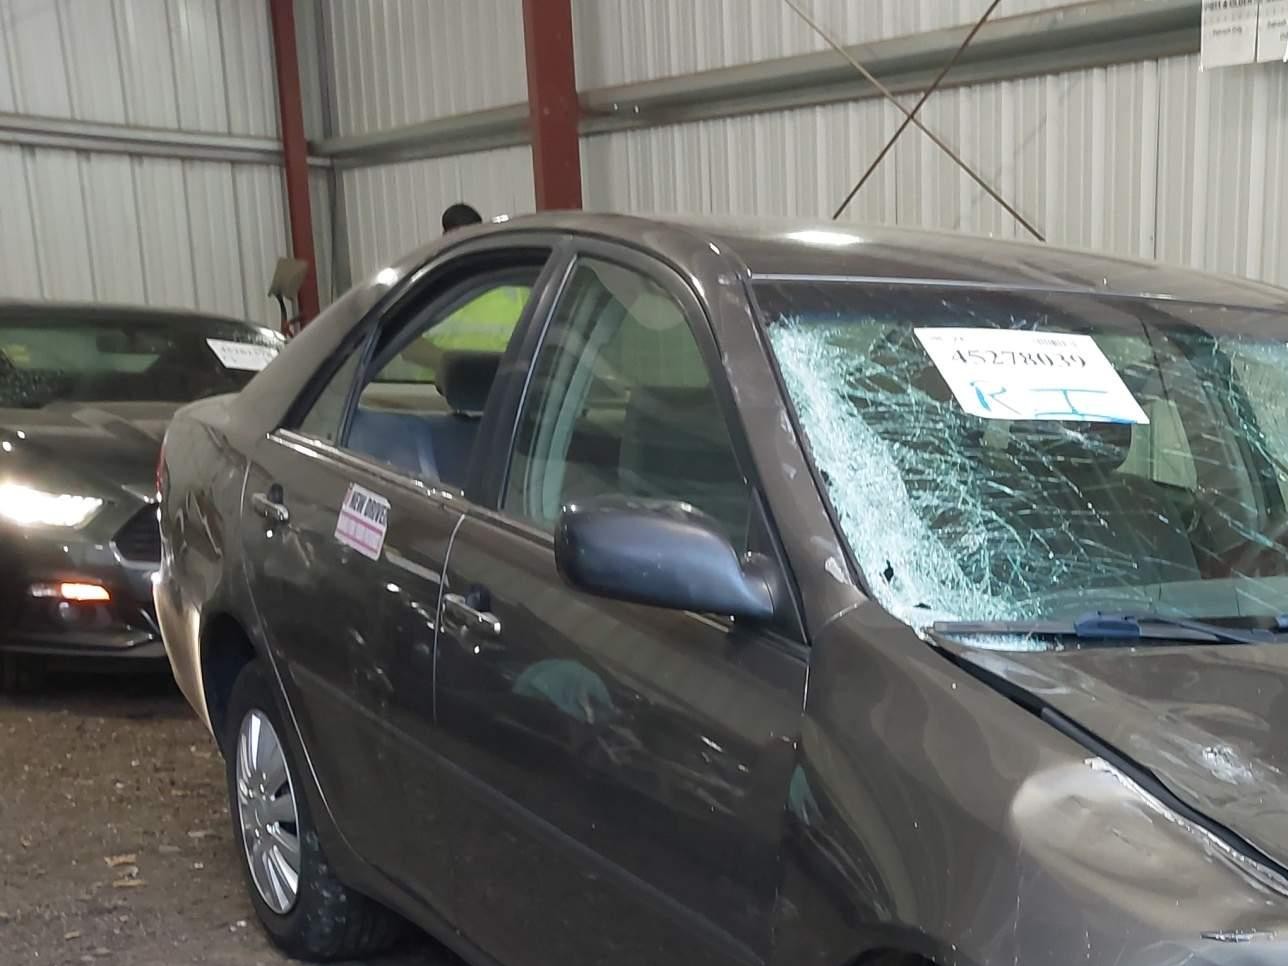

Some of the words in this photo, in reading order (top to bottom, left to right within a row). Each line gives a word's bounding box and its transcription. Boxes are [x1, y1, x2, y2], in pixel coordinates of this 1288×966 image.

[951, 348, 1088, 368] 45278039
[349, 490, 368, 514] NEW
[363, 496, 388, 527] DRIVE
